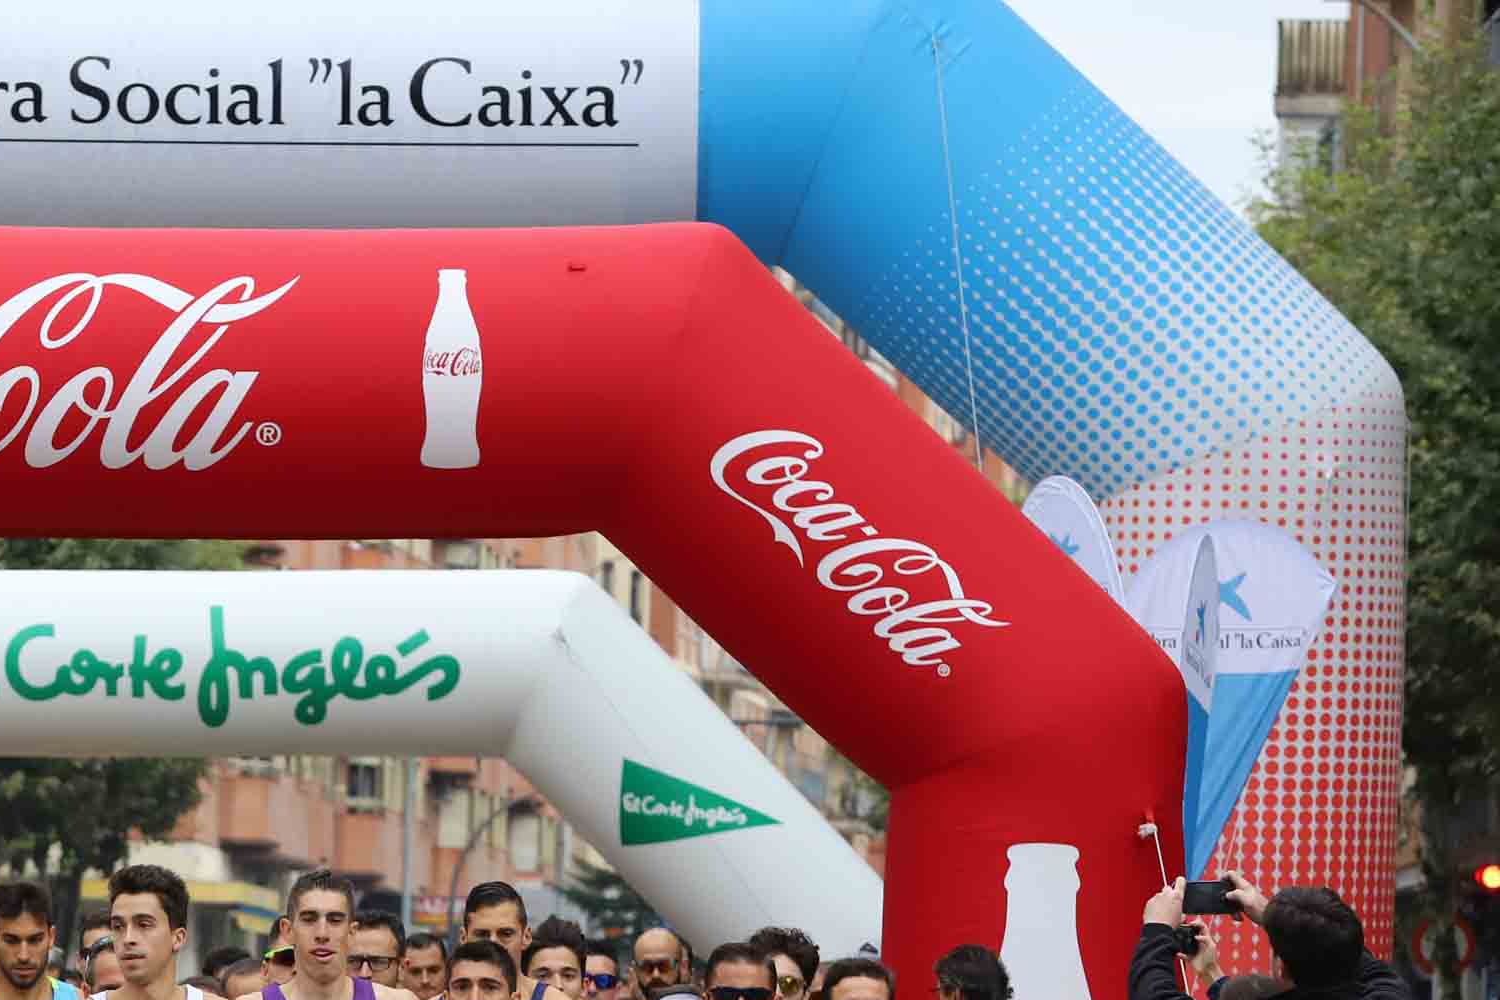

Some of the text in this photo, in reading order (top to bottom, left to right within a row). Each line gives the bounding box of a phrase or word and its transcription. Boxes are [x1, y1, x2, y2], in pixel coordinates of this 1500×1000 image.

[69, 55, 283, 126] Social
[5, 624, 186, 700] Corte
[197, 605, 461, 727] Inglés
[641, 795, 684, 817] Corte
